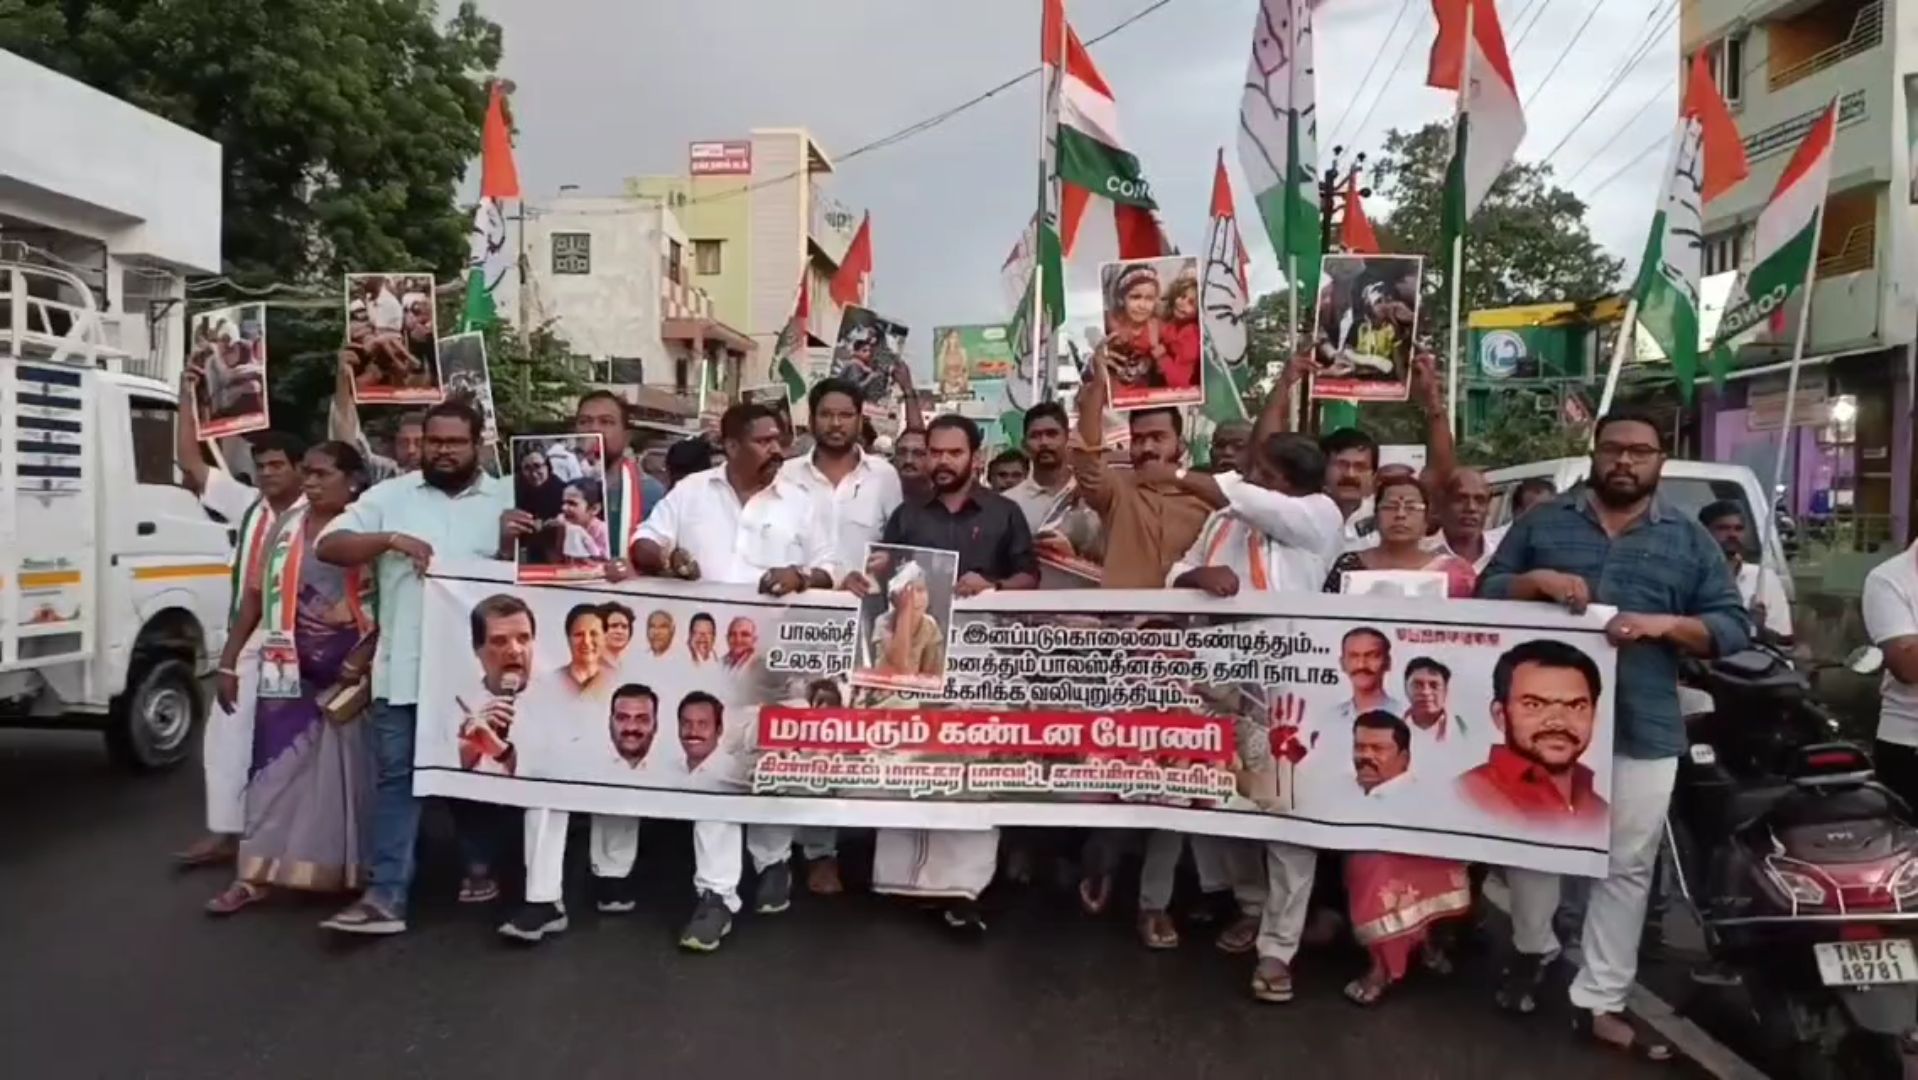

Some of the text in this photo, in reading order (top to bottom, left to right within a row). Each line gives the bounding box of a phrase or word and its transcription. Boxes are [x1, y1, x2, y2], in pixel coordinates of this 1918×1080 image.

[780, 619, 855, 646] பாலஸ்தீ
[962, 623, 1180, 650] இனப்படுகொலையை
[769, 649, 822, 669] உலக
[947, 652, 1036, 679] னைத்தும்
[1041, 650, 1207, 678] பாலஸ்தீனத்தை
[1214, 659, 1258, 682] தனி
[1264, 668, 1338, 687] நாடாக
[770, 714, 1222, 751] மாபெரும் கண்டன பேரணி
[1841, 961, 1903, 981] A8781
